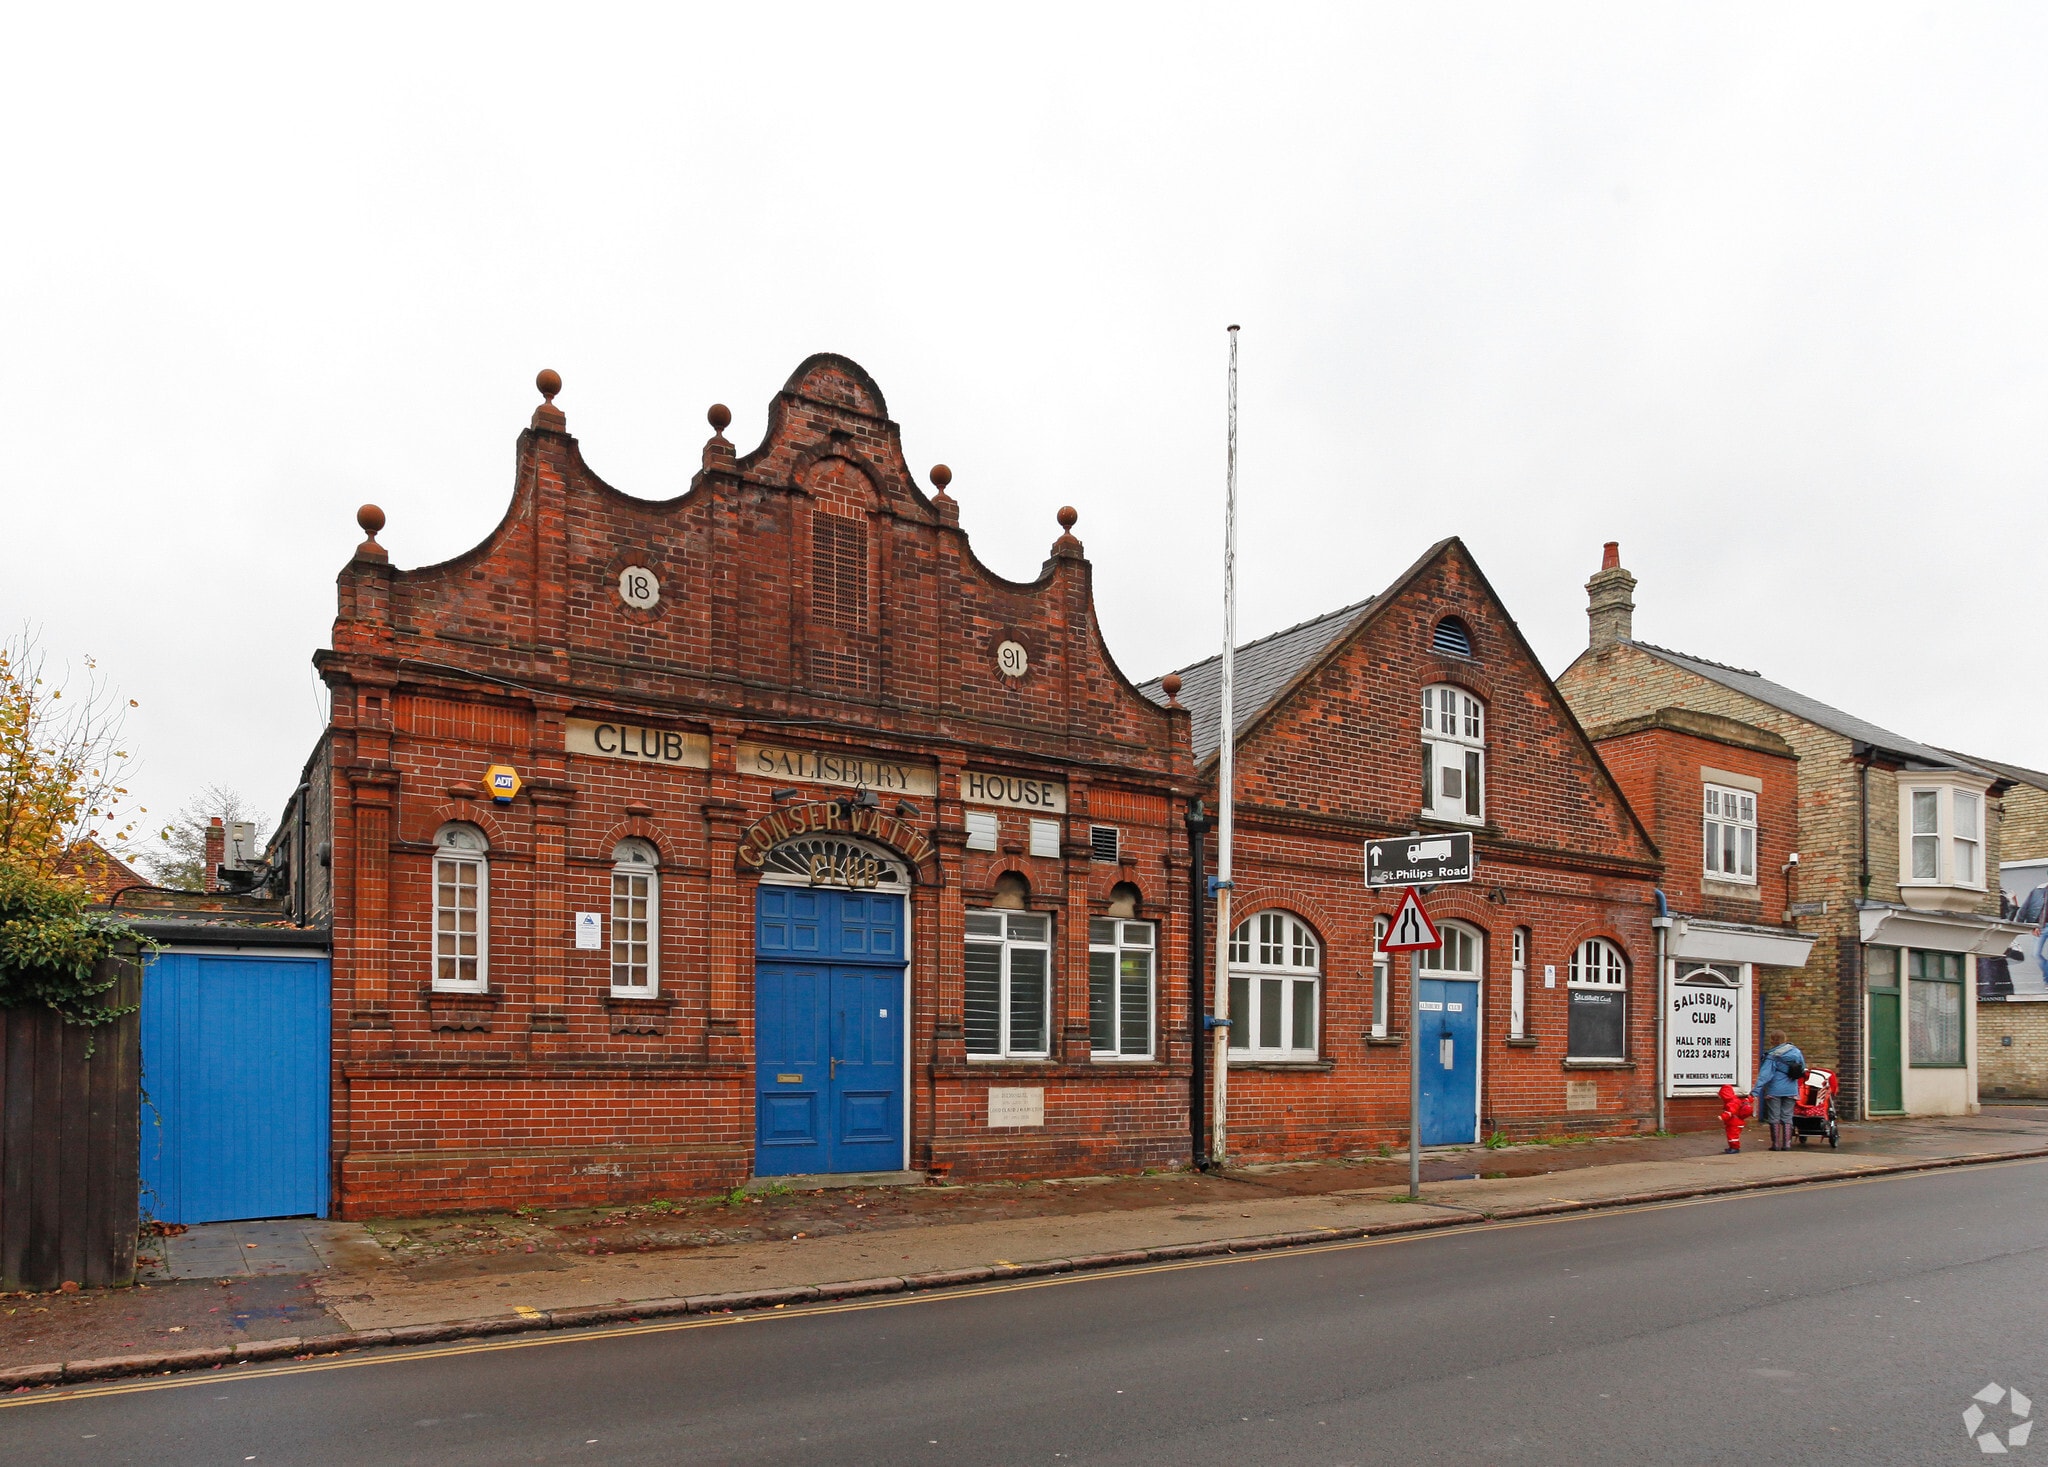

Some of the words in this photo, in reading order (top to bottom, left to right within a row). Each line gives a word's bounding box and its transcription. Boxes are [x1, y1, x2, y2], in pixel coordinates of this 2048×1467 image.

[628, 574, 650, 600] 18
[1002, 648, 1020, 670] 91
[594, 723, 684, 762] CLUB
[757, 748, 914, 790] SALISBURY
[495, 776, 513, 787] ADT
[969, 774, 1055, 808] HOUSE
[810, 853, 879, 888] CLUB
[1438, 866, 1469, 877] Road
[1674, 993, 1733, 1013] SALISBURY
[1692, 1012, 1716, 1024] CLUB
[1676, 1036, 1694, 1046] HALL
[1697, 1037, 1712, 1046] FOR
[1714, 1037, 1731, 1046] HIRE
[1677, 1049, 1699, 1058] 01223
[1702, 1049, 1730, 1059] 248734
